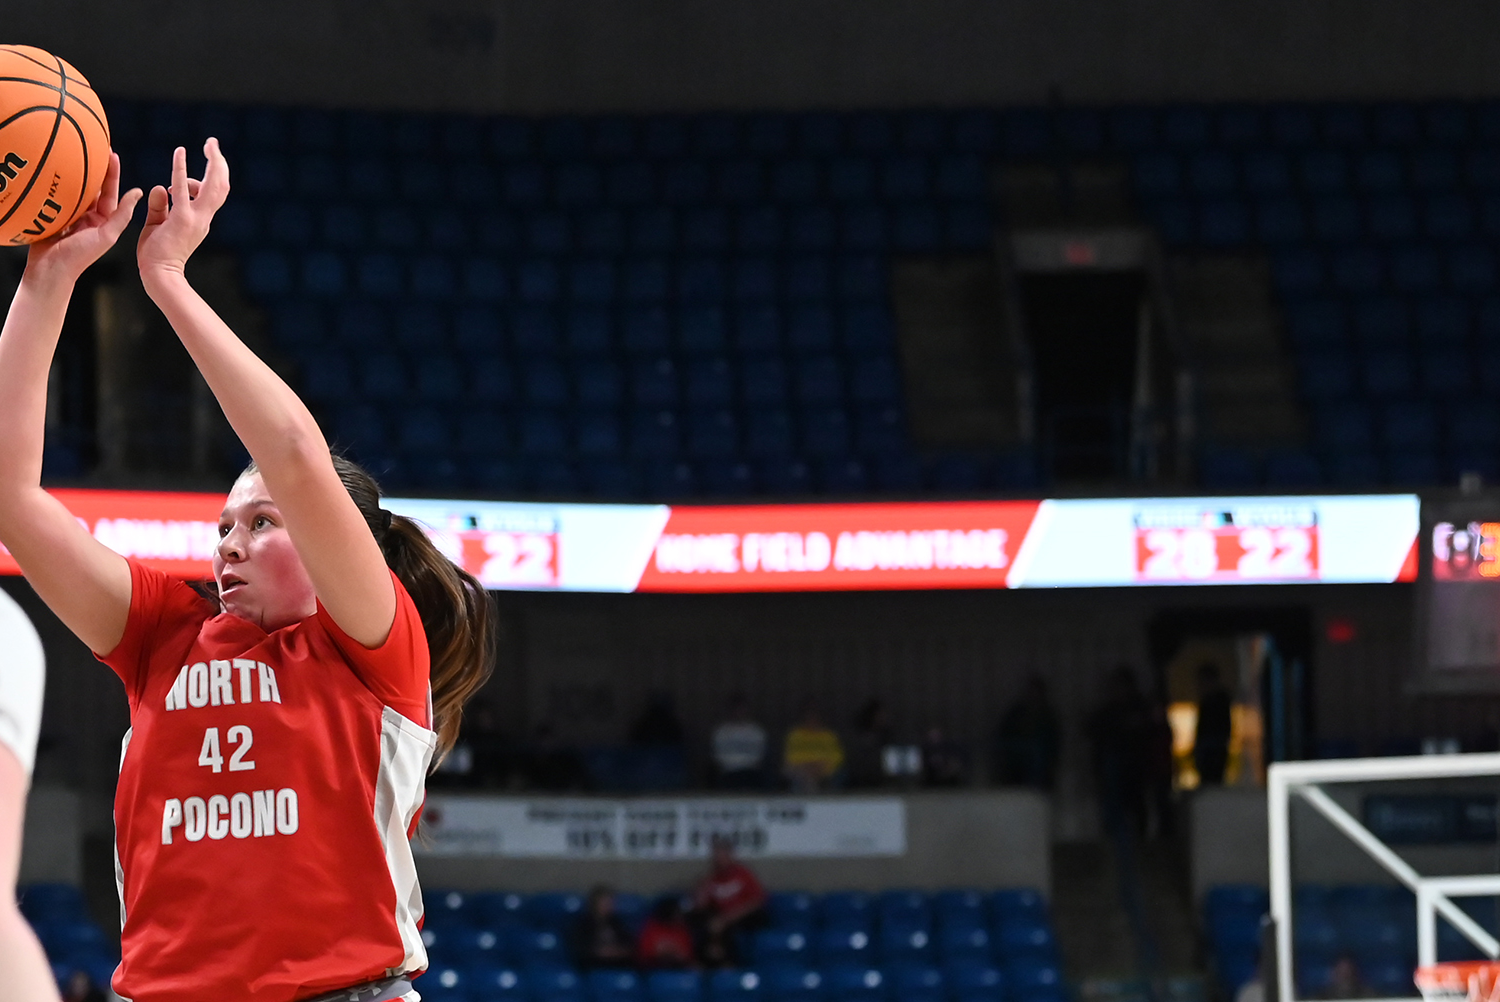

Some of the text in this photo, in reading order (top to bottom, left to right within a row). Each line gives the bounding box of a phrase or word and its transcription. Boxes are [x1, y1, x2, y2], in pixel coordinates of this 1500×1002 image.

[655, 528, 1009, 573] HOME FIELD ADVANTAGE
[1237, 527, 1310, 578] 22
[164, 658, 282, 711] NORTH
[197, 724, 256, 774] 42
[161, 787, 299, 846] POCONO
